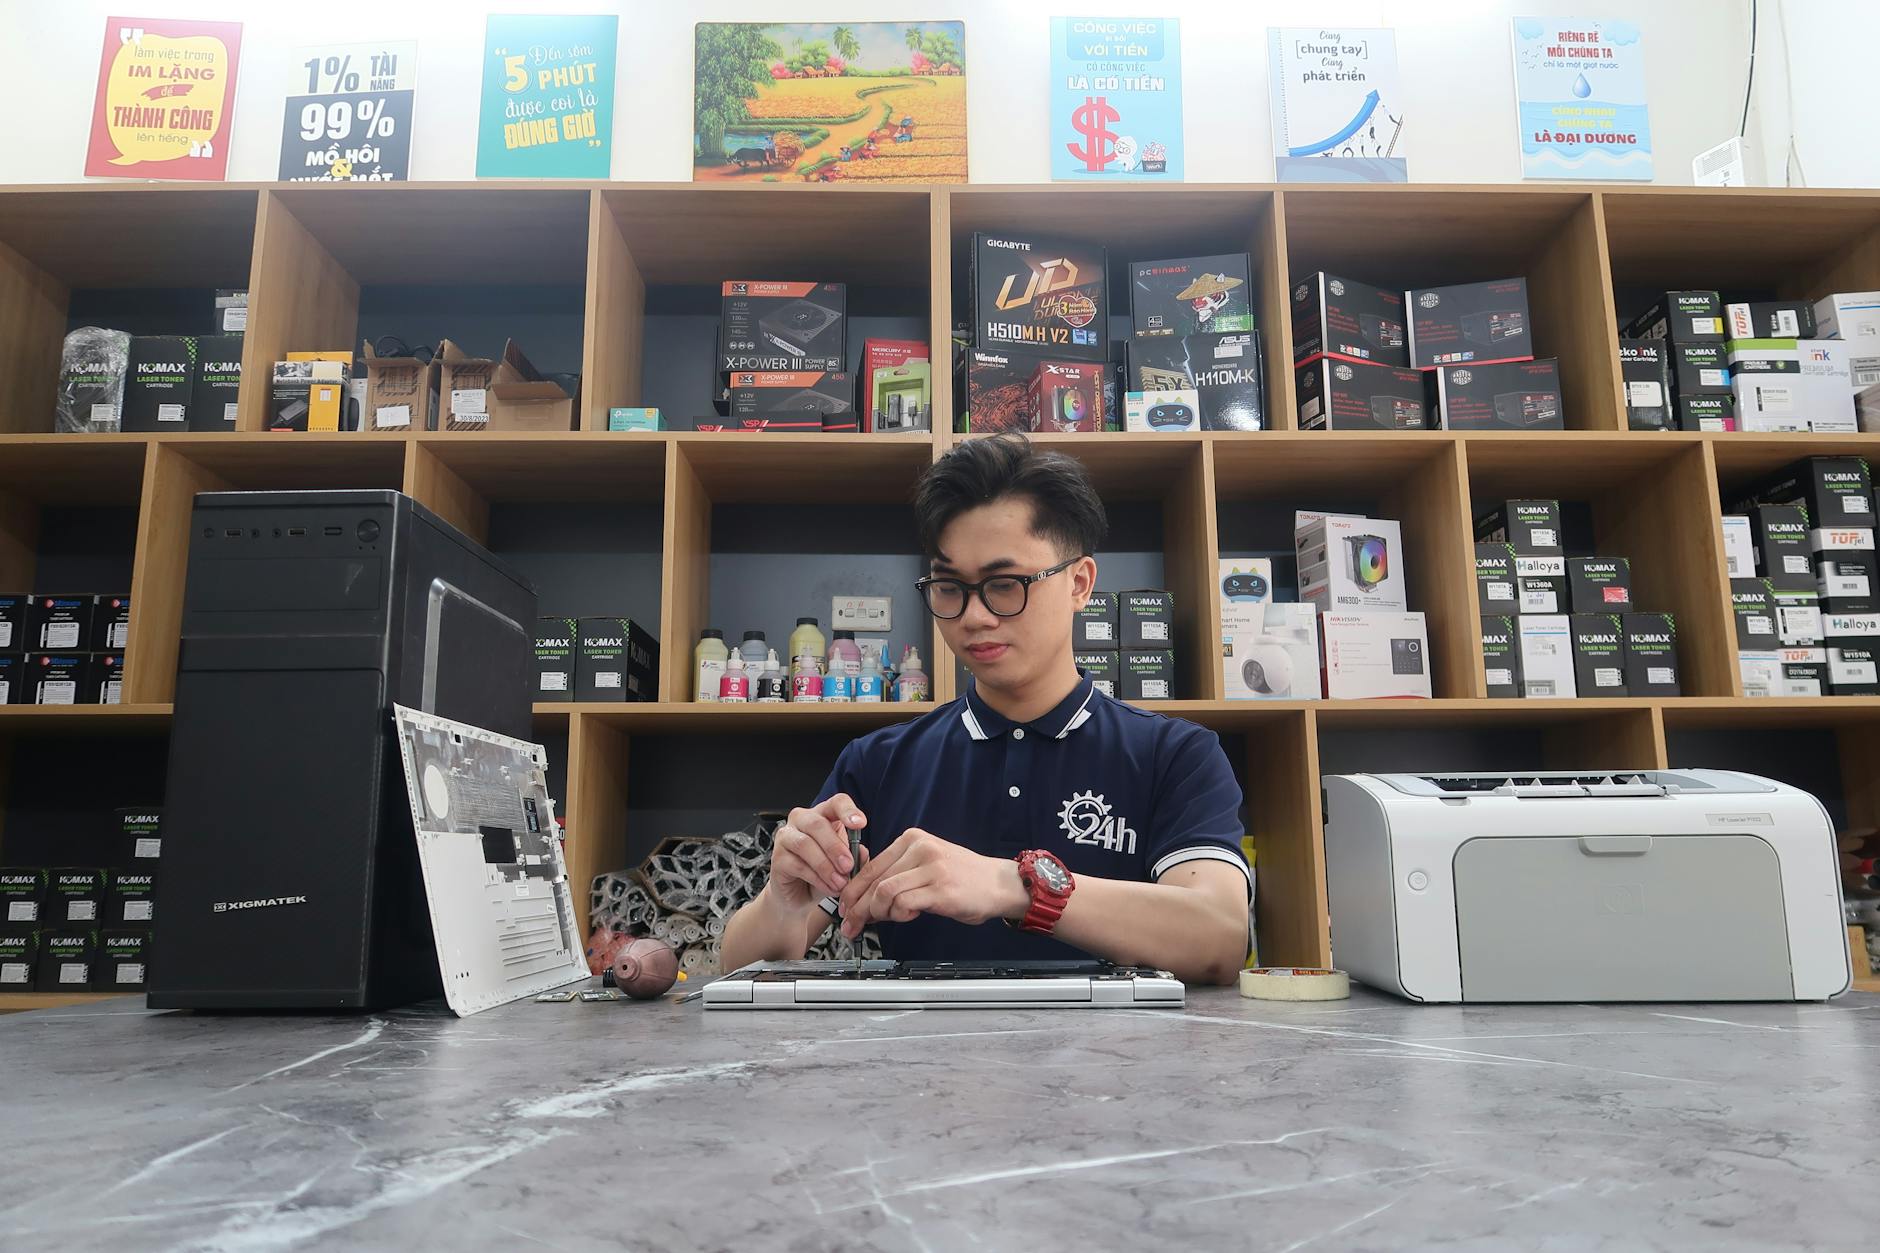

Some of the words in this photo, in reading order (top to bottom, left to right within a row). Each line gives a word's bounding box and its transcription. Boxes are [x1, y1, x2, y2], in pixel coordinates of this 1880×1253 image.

[1558, 31, 1586, 43] RIÊNG
[135, 46, 154, 58] làm
[158, 46, 180, 61] việc
[184, 48, 214, 63] trong
[1602, 47, 1613, 58] TA
[371, 51, 397, 77] TÀI
[128, 65, 151, 78] IM
[158, 63, 214, 82] LẶNG
[305, 55, 359, 94] 1%
[538, 61, 596, 90] PHÚT
[1303, 71, 1332, 83] phát
[1335, 66, 1365, 81] triển
[370, 79, 395, 91] NĂNG
[1068, 74, 1089, 91] LÀ
[1094, 75, 1119, 91] CÓ
[160, 85, 176, 97] để
[506, 98, 545, 119] được
[551, 95, 576, 111] coi
[578, 88, 599, 107] là
[114, 104, 165, 129] THÀNH
[169, 106, 213, 131] CÔNG
[504, 117, 558, 150] ĐÚNG
[562, 108, 596, 141] GIỜ
[137, 133, 155, 143] lên
[159, 133, 189, 146] tiếng
[1535, 129, 1552, 143] LÀ
[1553, 132, 1581, 146] ĐẠI
[1584, 132, 1637, 144] DƯƠNG
[305, 142, 341, 166] MỒ
[346, 144, 380, 164] HÔI
[331, 158, 352, 178] &
[987, 239, 1031, 251] GIGABYTE
[1050, 327, 1069, 344] V2
[1219, 335, 1250, 346] ASUS
[137, 362, 185, 374] KOMAX
[204, 362, 241, 374] KOMA
[726, 357, 788, 370] X-POWER
[791, 357, 803, 370] III
[1046, 364, 1080, 375] X-STAR
[203, 375, 224, 383] LASER
[1195, 369, 1255, 387] H110M-K
[1824, 473, 1861, 481] KOMAX
[1517, 506, 1549, 514] KOMAX
[1768, 523, 1804, 532] KOMAX
[1518, 560, 1559, 574] Halloya
[1584, 564, 1616, 572] KOMAX
[1130, 598, 1162, 606] KOMAX
[1833, 618, 1877, 632] Halloya
[584, 638, 623, 647] KOMAX
[1579, 634, 1617, 643] KOMAX
[1631, 634, 1670, 642] KOMAX
[1075, 656, 1108, 664] KOMAX
[1130, 656, 1162, 664] KOMAX
[124, 815, 159, 824] KOMAX
[1075, 812, 1137, 855] 24h
[1, 876, 35, 885] KOMAX
[59, 876, 94, 885] KOMAX
[117, 876, 152, 885] KOMAX
[228, 895, 307, 910] XIGMATEK
[50, 938, 85, 947] KOMAX
[107, 938, 142, 947] KOMAX
